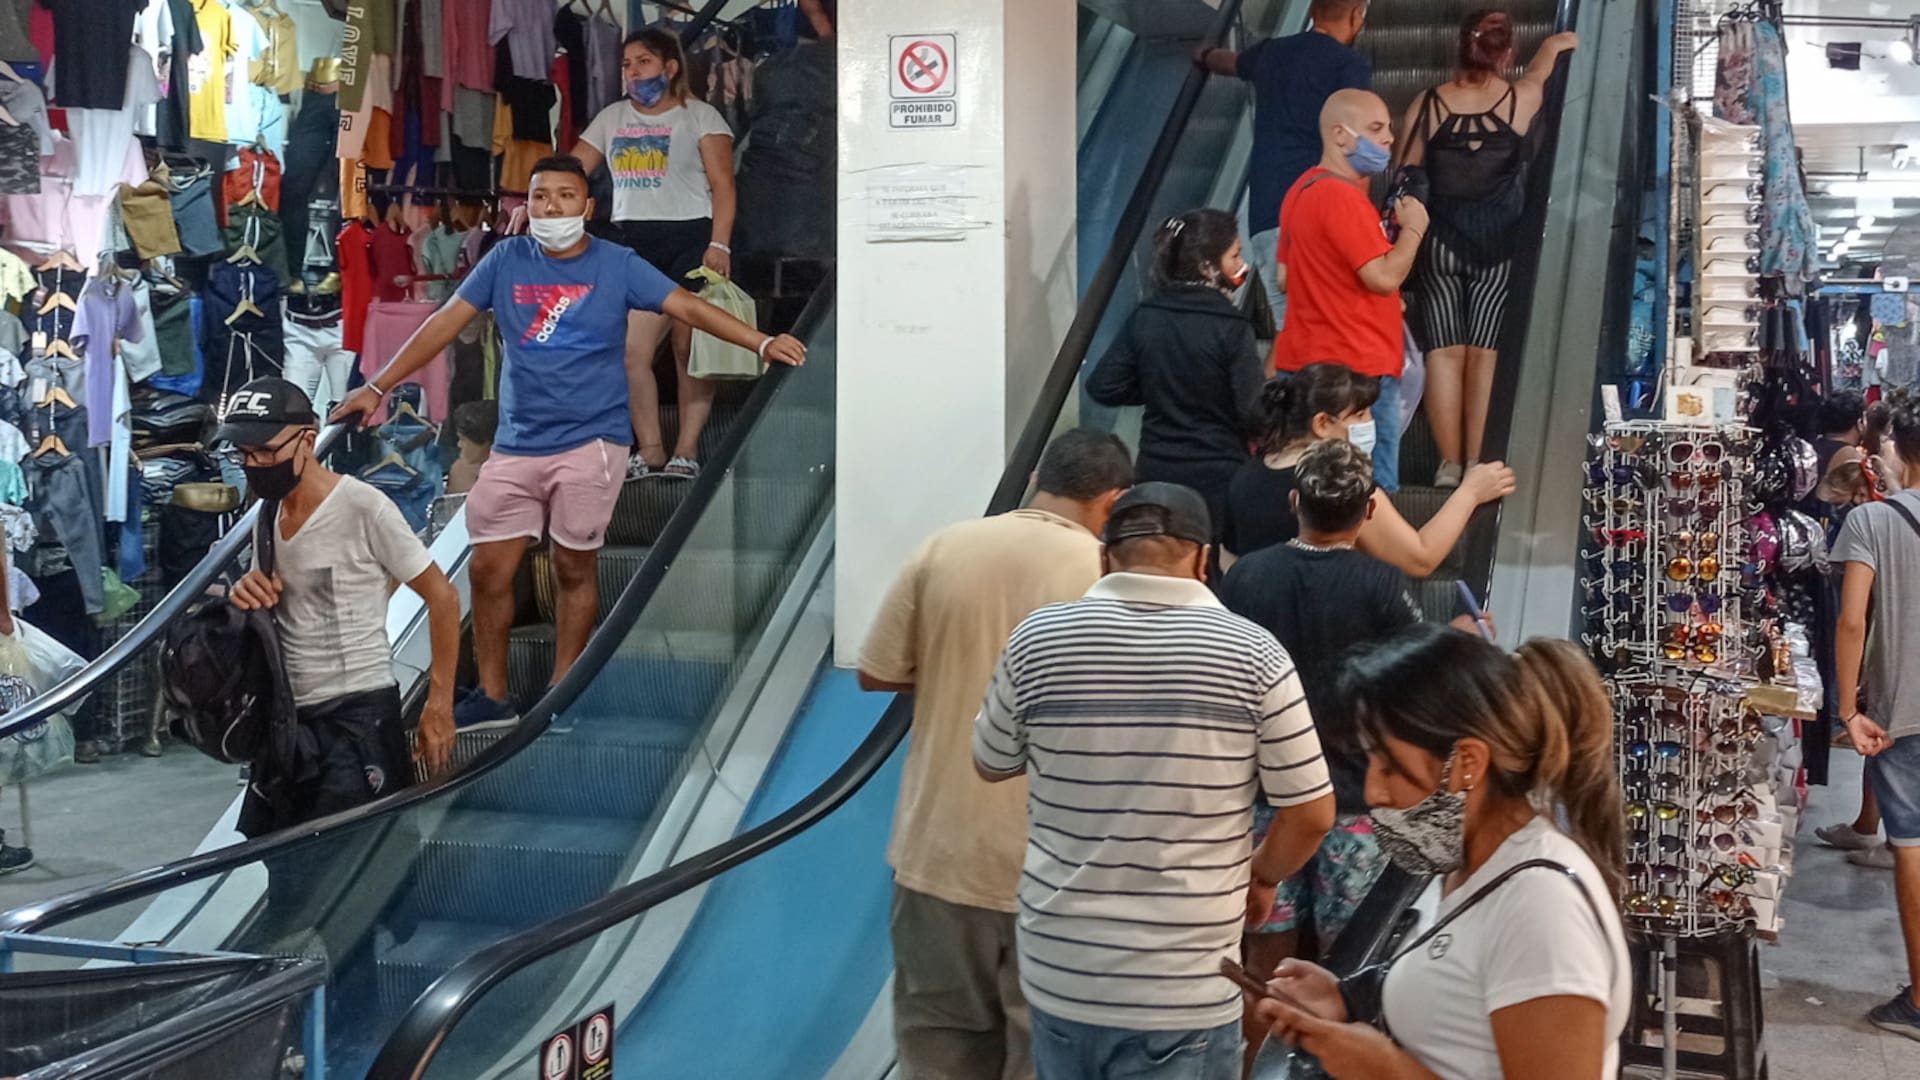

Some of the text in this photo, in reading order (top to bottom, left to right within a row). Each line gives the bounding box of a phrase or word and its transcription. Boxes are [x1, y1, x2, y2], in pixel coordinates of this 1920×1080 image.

[893, 103, 953, 114] PROHIBIDO
[903, 114, 942, 124] FUMAR
[536, 295, 571, 343] adidas
